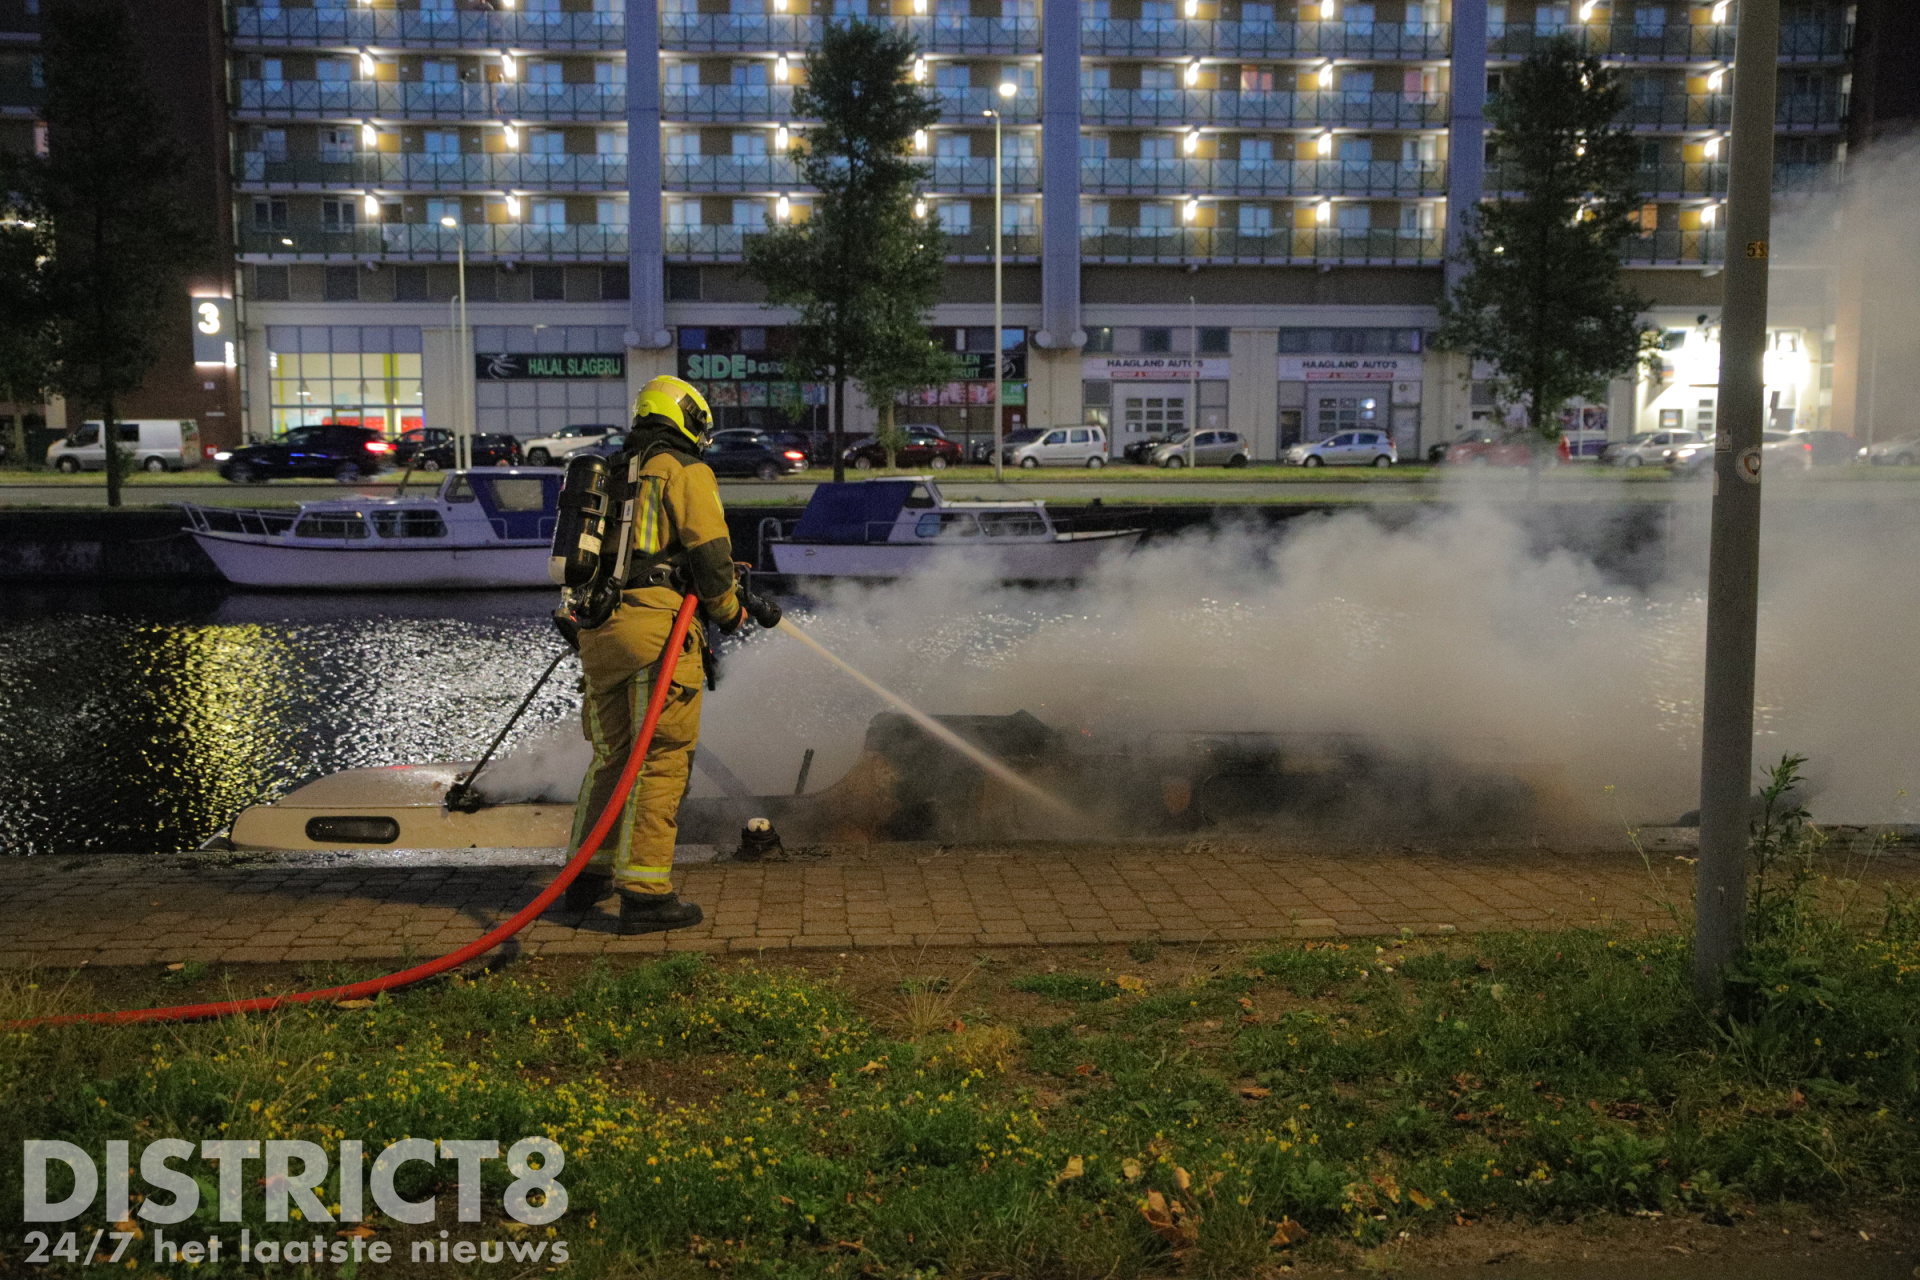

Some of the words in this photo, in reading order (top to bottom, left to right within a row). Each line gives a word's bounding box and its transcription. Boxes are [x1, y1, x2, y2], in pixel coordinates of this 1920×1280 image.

[198, 302, 220, 334] 3
[528, 358, 566, 375] HALAL
[567, 358, 621, 375] SLAGERIJ
[687, 354, 747, 380] SIDE
[1107, 359, 1165, 368] HAAGLAND
[1302, 360, 1359, 369] HAAGLAND
[1362, 360, 1398, 369] AUTO'S
